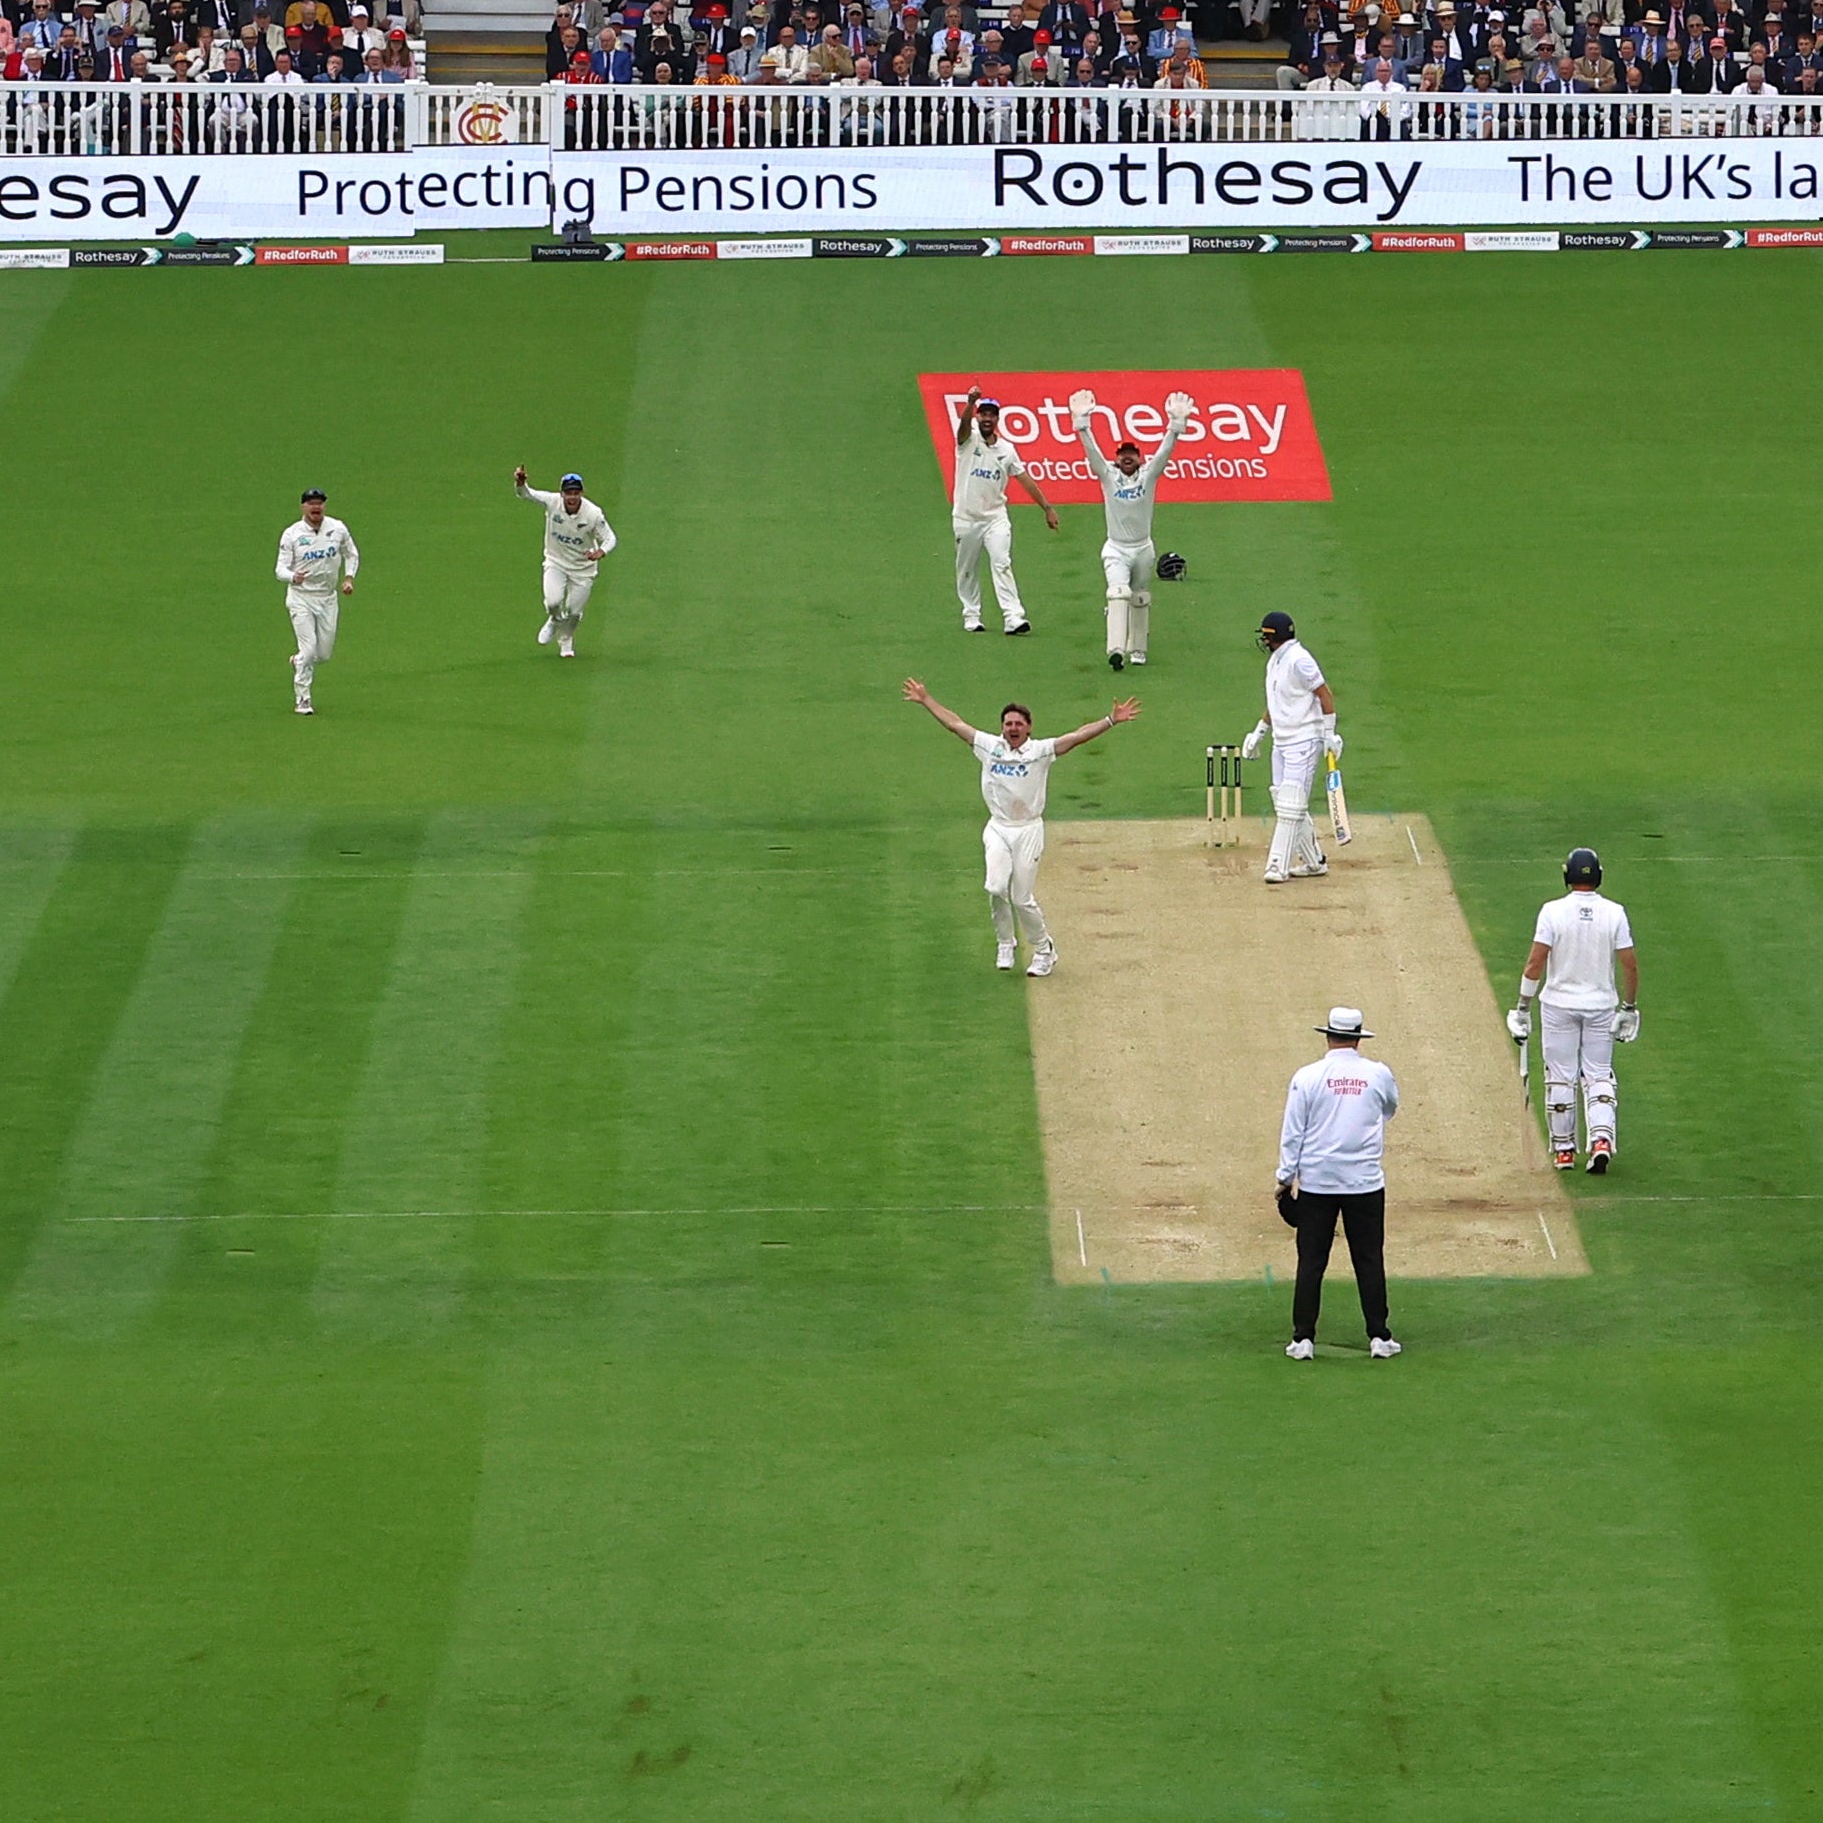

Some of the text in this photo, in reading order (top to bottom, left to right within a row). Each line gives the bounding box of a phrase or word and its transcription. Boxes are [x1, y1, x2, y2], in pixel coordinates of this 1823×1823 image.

[994, 147, 1422, 221] Rothesay
[1508, 153, 1612, 202] The
[1637, 154, 1752, 201] UK's
[299, 159, 877, 222] Protecting Pensions
[820, 240, 882, 254] Rothesay
[1010, 239, 1085, 251] #RedforRuth
[1192, 238, 1255, 250] Rothesay
[1381, 236, 1456, 248] #RedforRuth
[1564, 234, 1627, 247] Rothesay
[263, 249, 338, 261] #RedforRuth
[636, 244, 710, 255] #RedforRuth
[75, 251, 138, 264] Rothesay
[989, 763, 1015, 776] ANZ
[1326, 1076, 1369, 1089] Emirates
